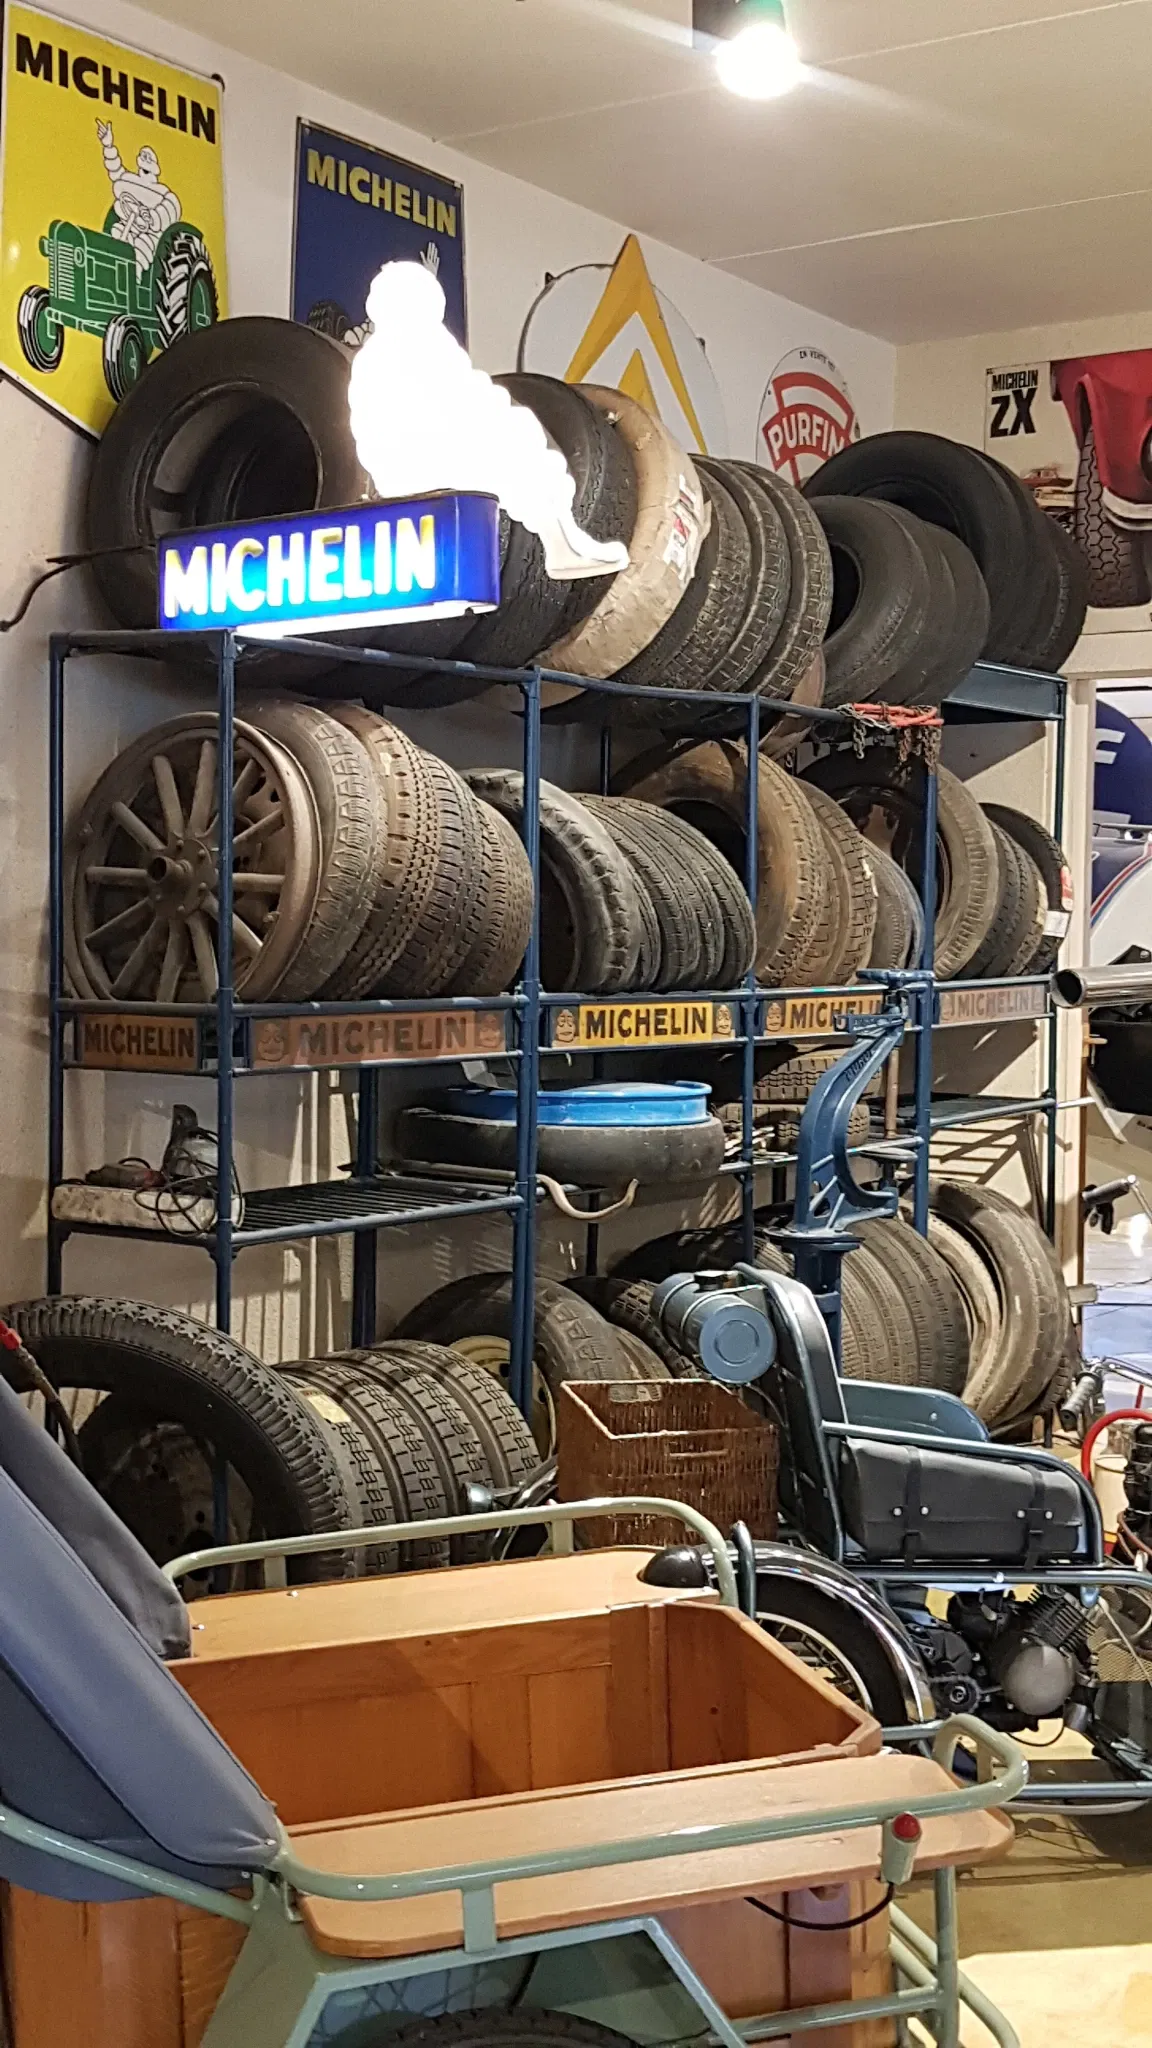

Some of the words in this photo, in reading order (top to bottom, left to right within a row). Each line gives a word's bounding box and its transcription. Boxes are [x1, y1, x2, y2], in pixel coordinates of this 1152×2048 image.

[16, 32, 216, 145] MICHELIN
[307, 148, 456, 237] MICHELIN
[991, 369, 1039, 392] MICHELIN
[990, 387, 1037, 438] ZX
[163, 514, 437, 619] MICHELIN
[585, 1006, 708, 1040] MICHELIN
[957, 988, 1032, 1018] MICHELIN
[84, 1023, 196, 1058] MICHELIN
[301, 1016, 467, 1056] MICHELIN
